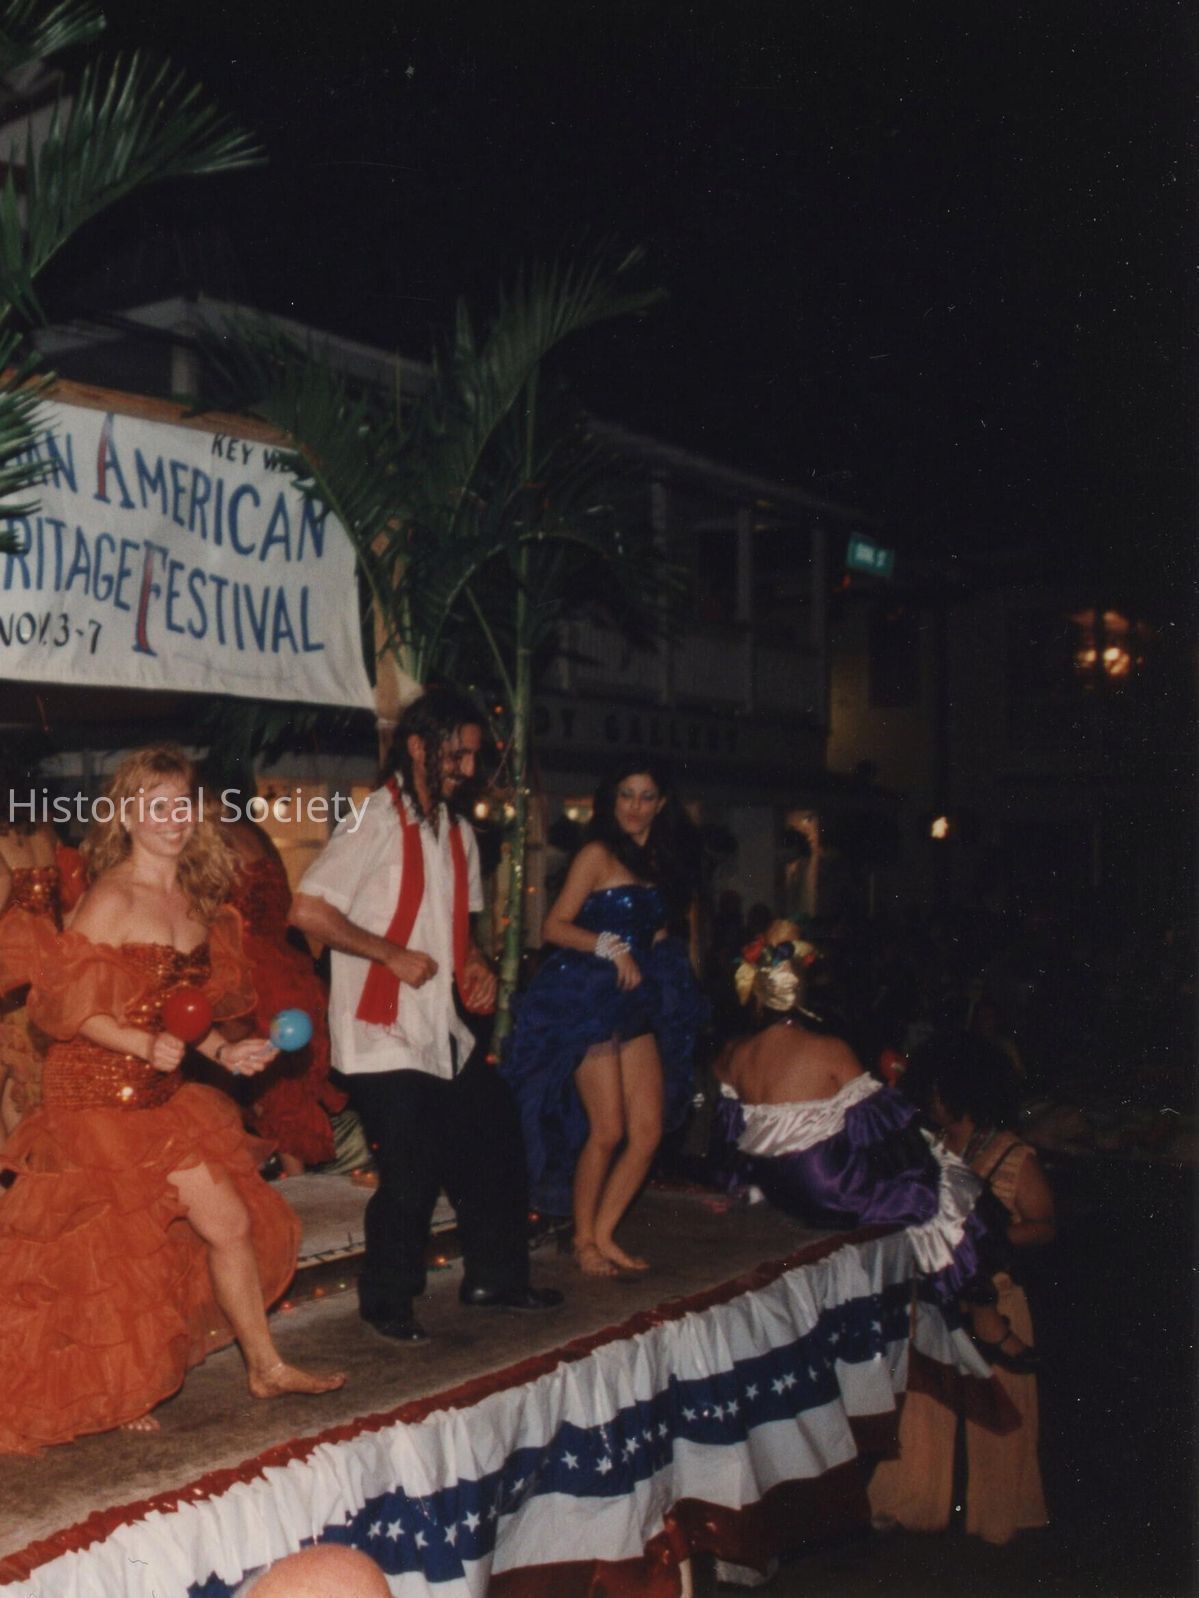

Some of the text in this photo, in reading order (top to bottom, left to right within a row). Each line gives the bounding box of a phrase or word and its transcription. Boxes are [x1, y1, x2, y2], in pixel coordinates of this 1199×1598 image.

[94, 412, 331, 563] AMERICAN
[211, 432, 254, 465] KEY
[131, 541, 325, 657] FESTIVAL
